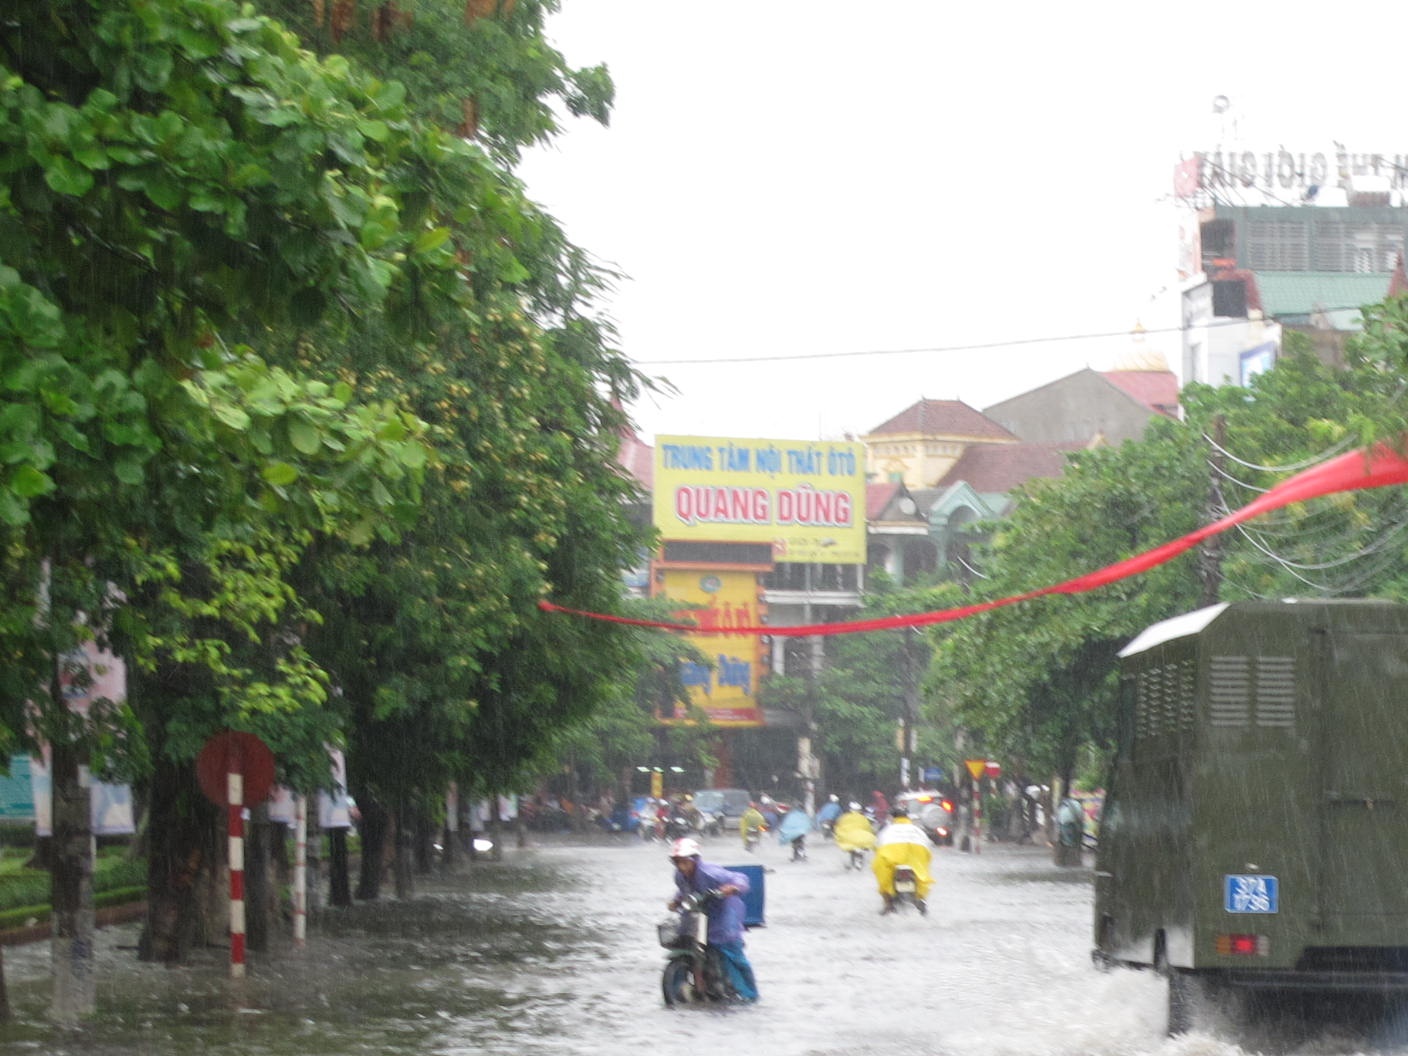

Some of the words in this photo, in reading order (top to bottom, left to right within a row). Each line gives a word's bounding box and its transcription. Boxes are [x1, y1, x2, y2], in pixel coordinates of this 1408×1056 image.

[662, 444, 713, 471] TRUNG
[674, 485, 771, 527] QUANG
[776, 481, 854, 528] DŨNG
